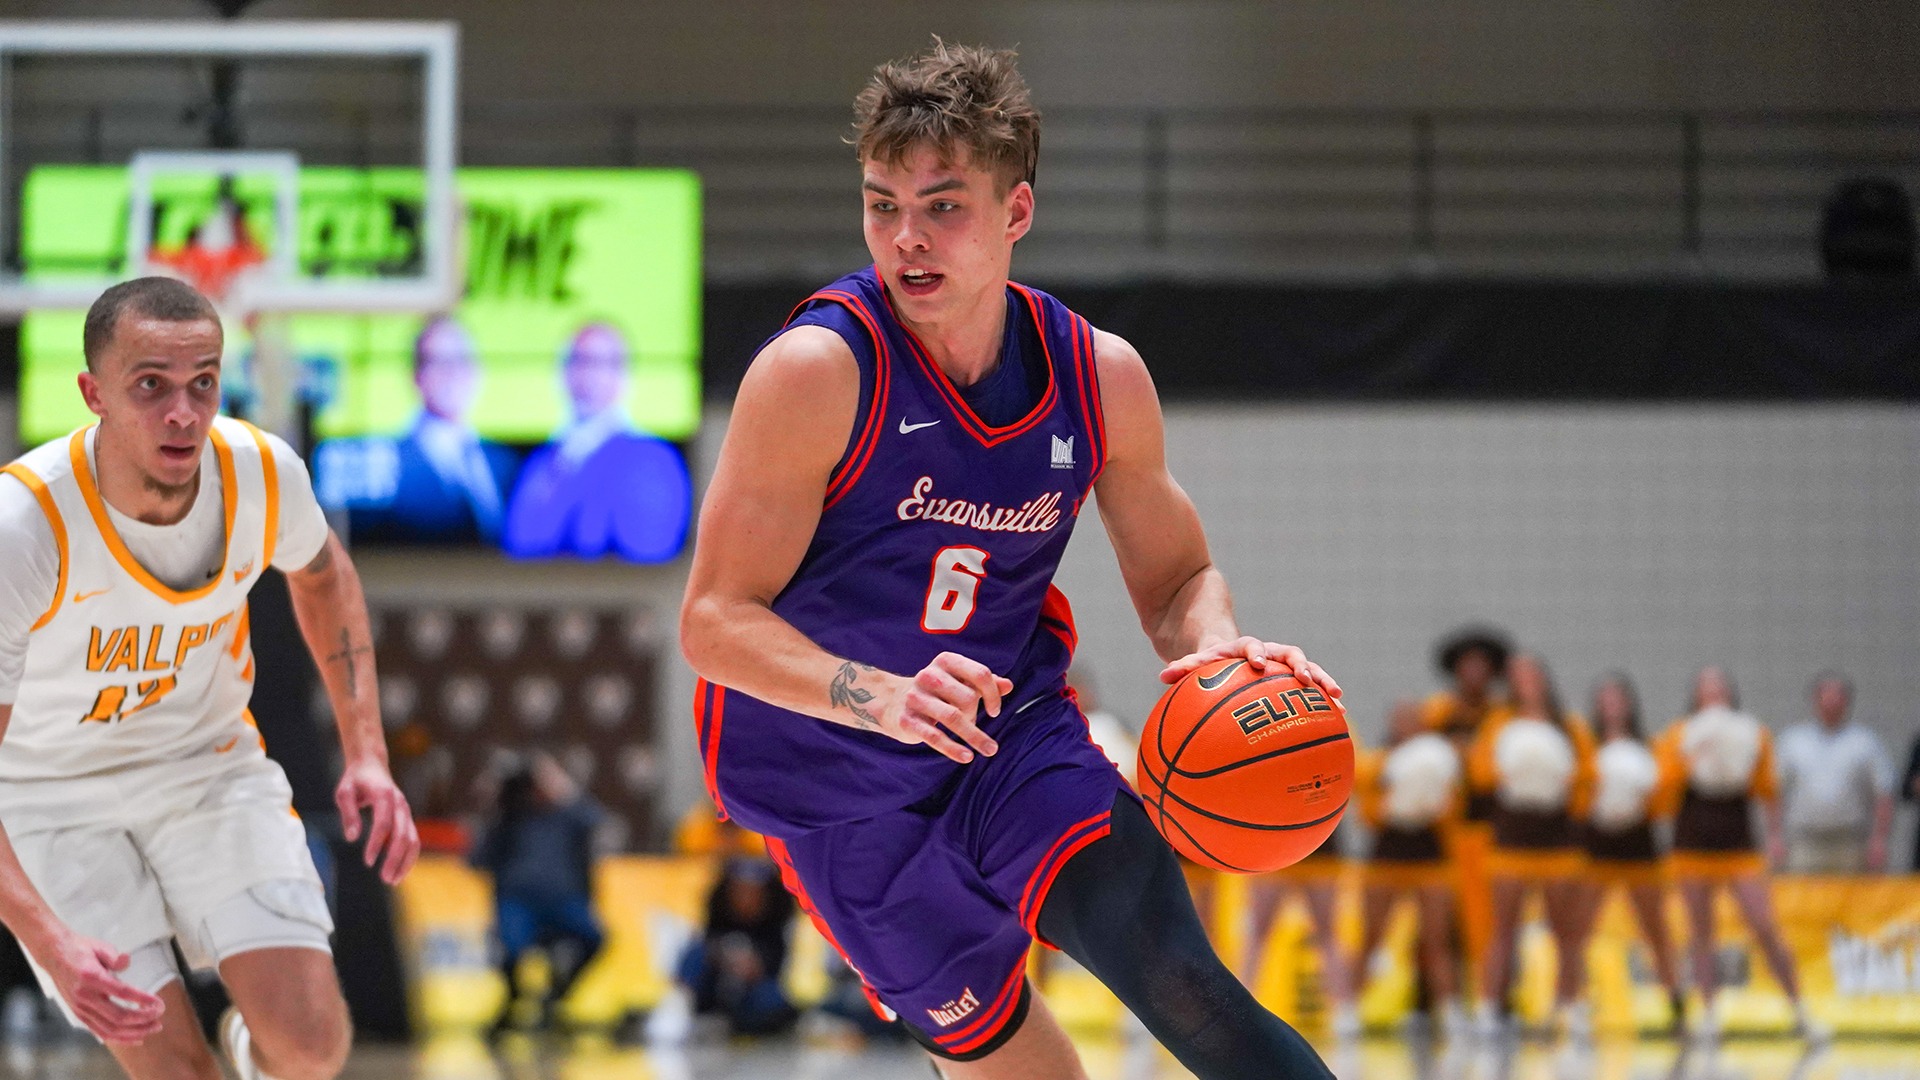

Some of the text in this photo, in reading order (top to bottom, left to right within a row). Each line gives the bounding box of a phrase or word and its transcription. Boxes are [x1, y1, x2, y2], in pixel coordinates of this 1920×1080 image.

[897, 476, 1063, 533] Evansville
[920, 544, 991, 634] 6
[1231, 687, 1333, 737] ELITE
[1247, 713, 1337, 745] CHAMPIONS
[926, 985, 981, 1028] VALLEY
